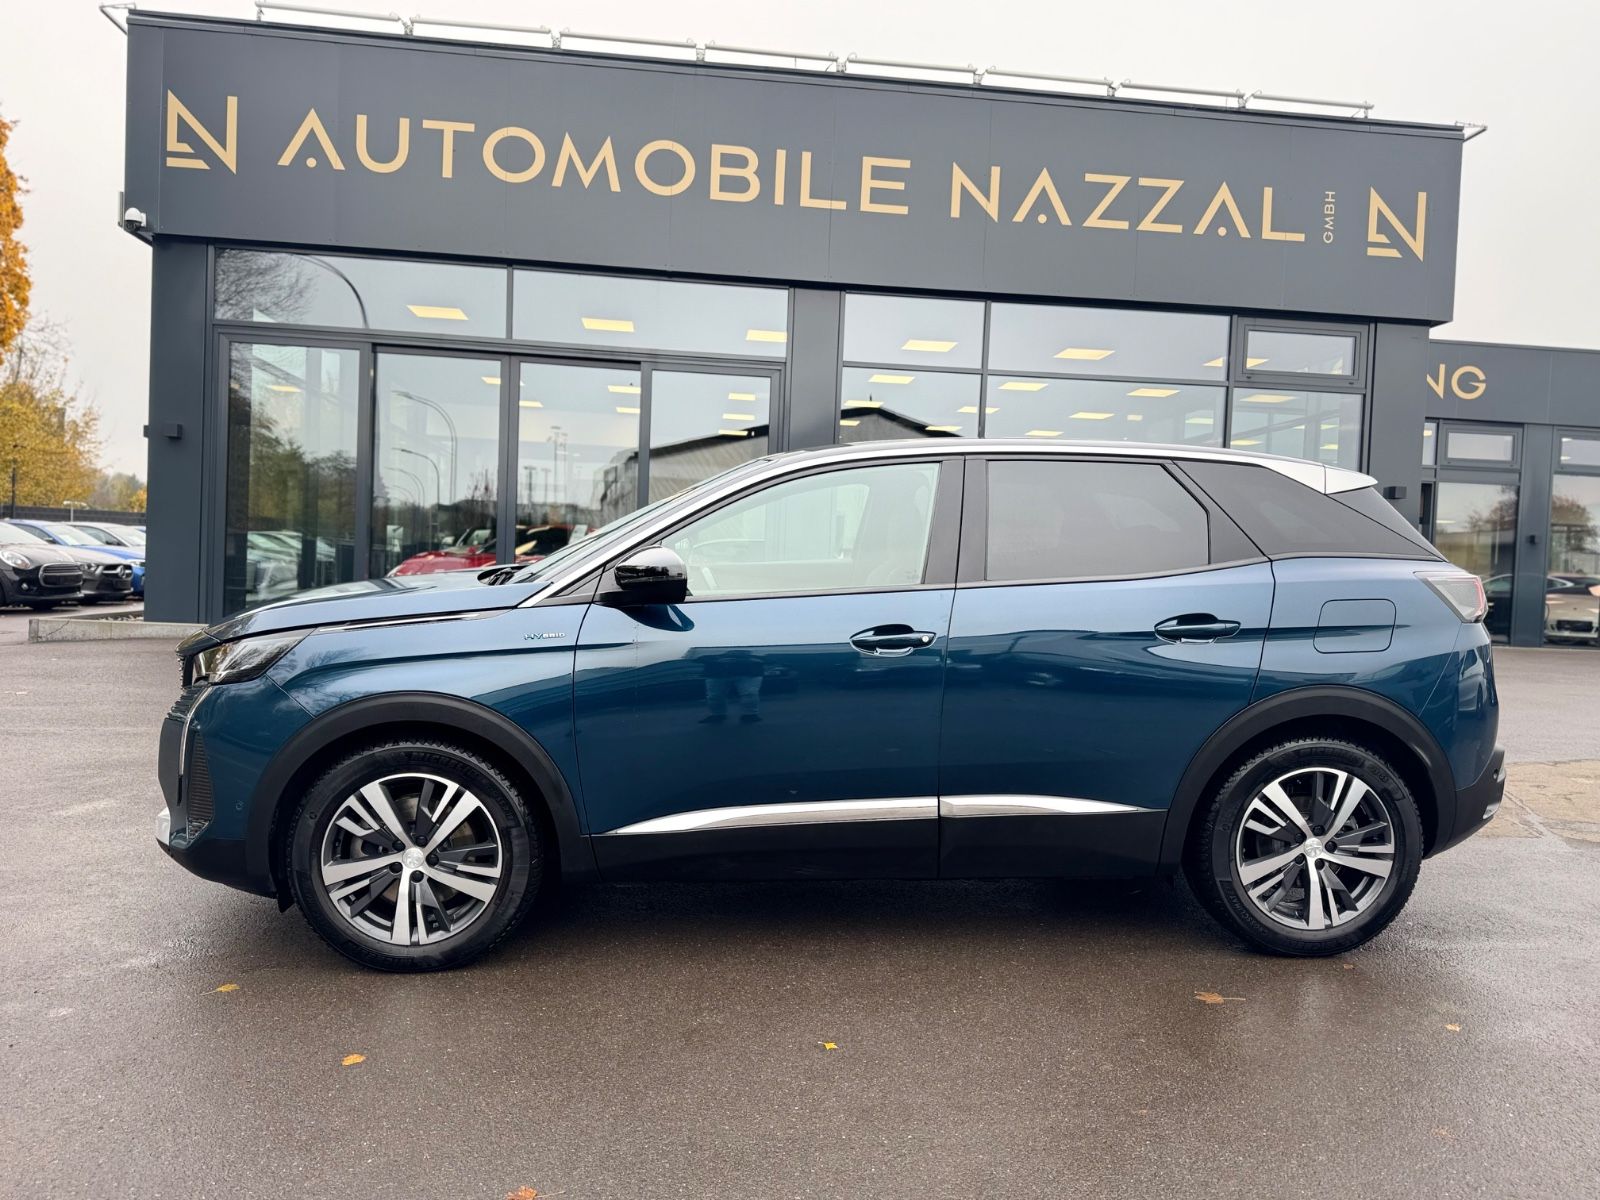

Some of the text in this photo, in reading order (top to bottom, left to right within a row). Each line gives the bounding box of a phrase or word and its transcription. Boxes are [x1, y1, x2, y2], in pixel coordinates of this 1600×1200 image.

[278, 108, 1305, 242] AUTOMOBILE NAZZAL
[1323, 191, 1336, 244] GMBH
